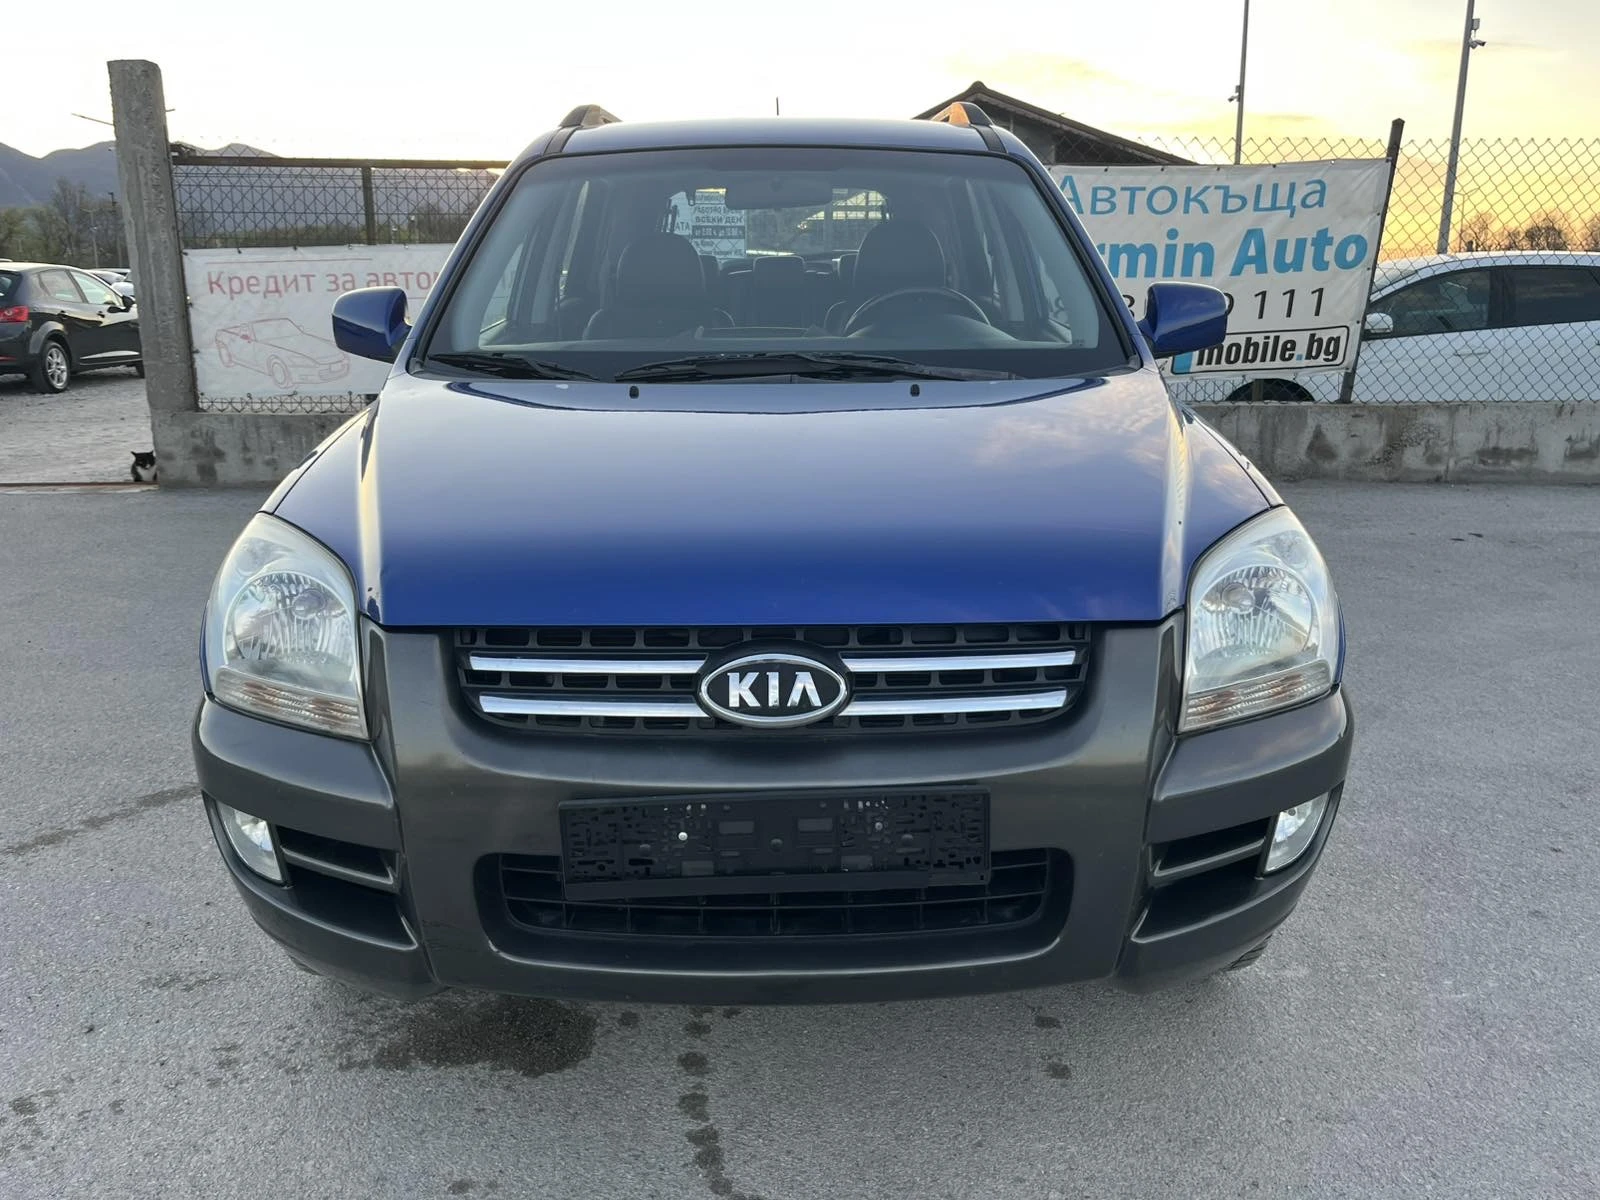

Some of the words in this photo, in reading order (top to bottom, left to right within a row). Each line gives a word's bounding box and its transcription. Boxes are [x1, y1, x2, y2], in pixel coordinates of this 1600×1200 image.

[1059, 174, 1328, 218] Автокъща
[1229, 228, 1369, 277] Auto
[206, 270, 316, 301] Кредит
[325, 272, 356, 293] за
[1195, 332, 1342, 366] mobile.bg
[727, 671, 823, 708] KIA
